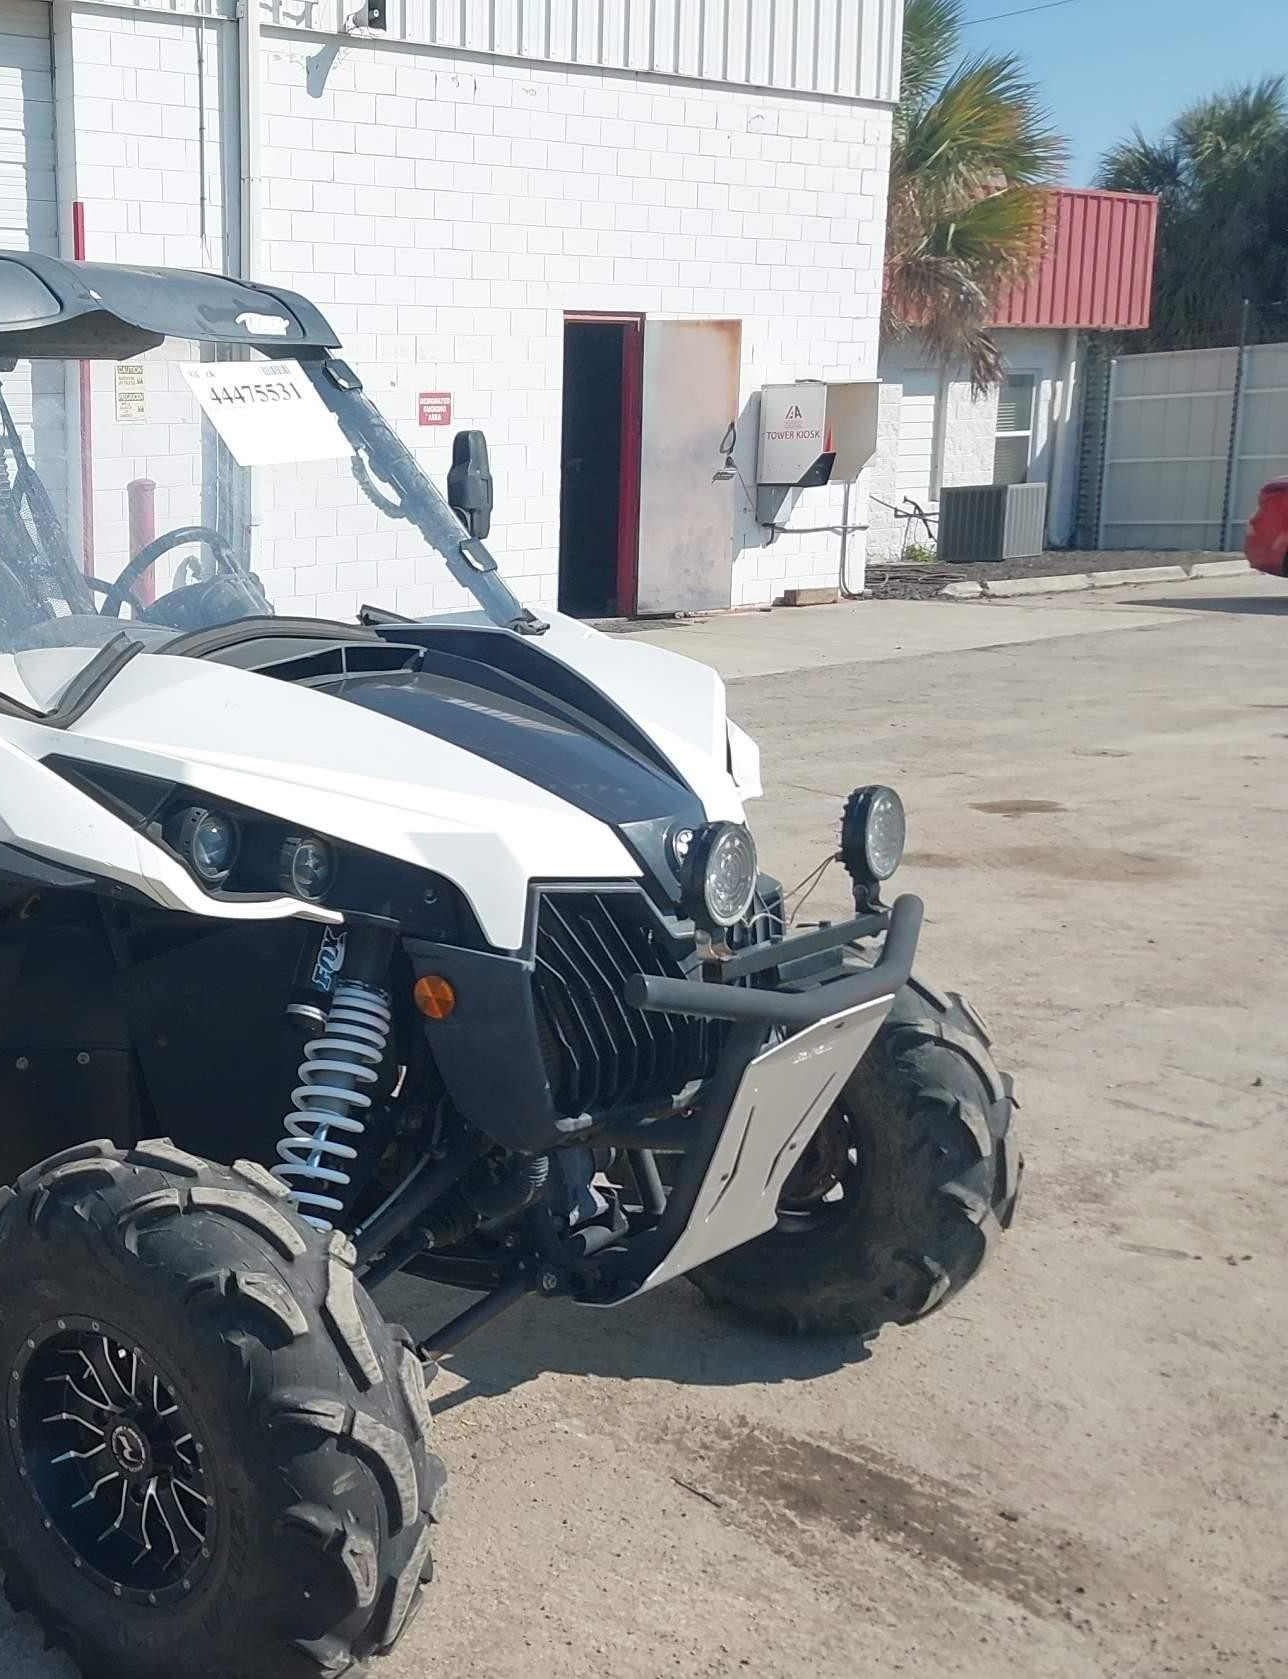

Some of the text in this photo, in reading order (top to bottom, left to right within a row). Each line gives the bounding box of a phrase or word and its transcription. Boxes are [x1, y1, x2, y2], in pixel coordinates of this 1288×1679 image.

[209, 382, 303, 405] 44475531
[766, 430, 820, 440] TOWER KIOSK
[312, 925, 348, 991] FOX
